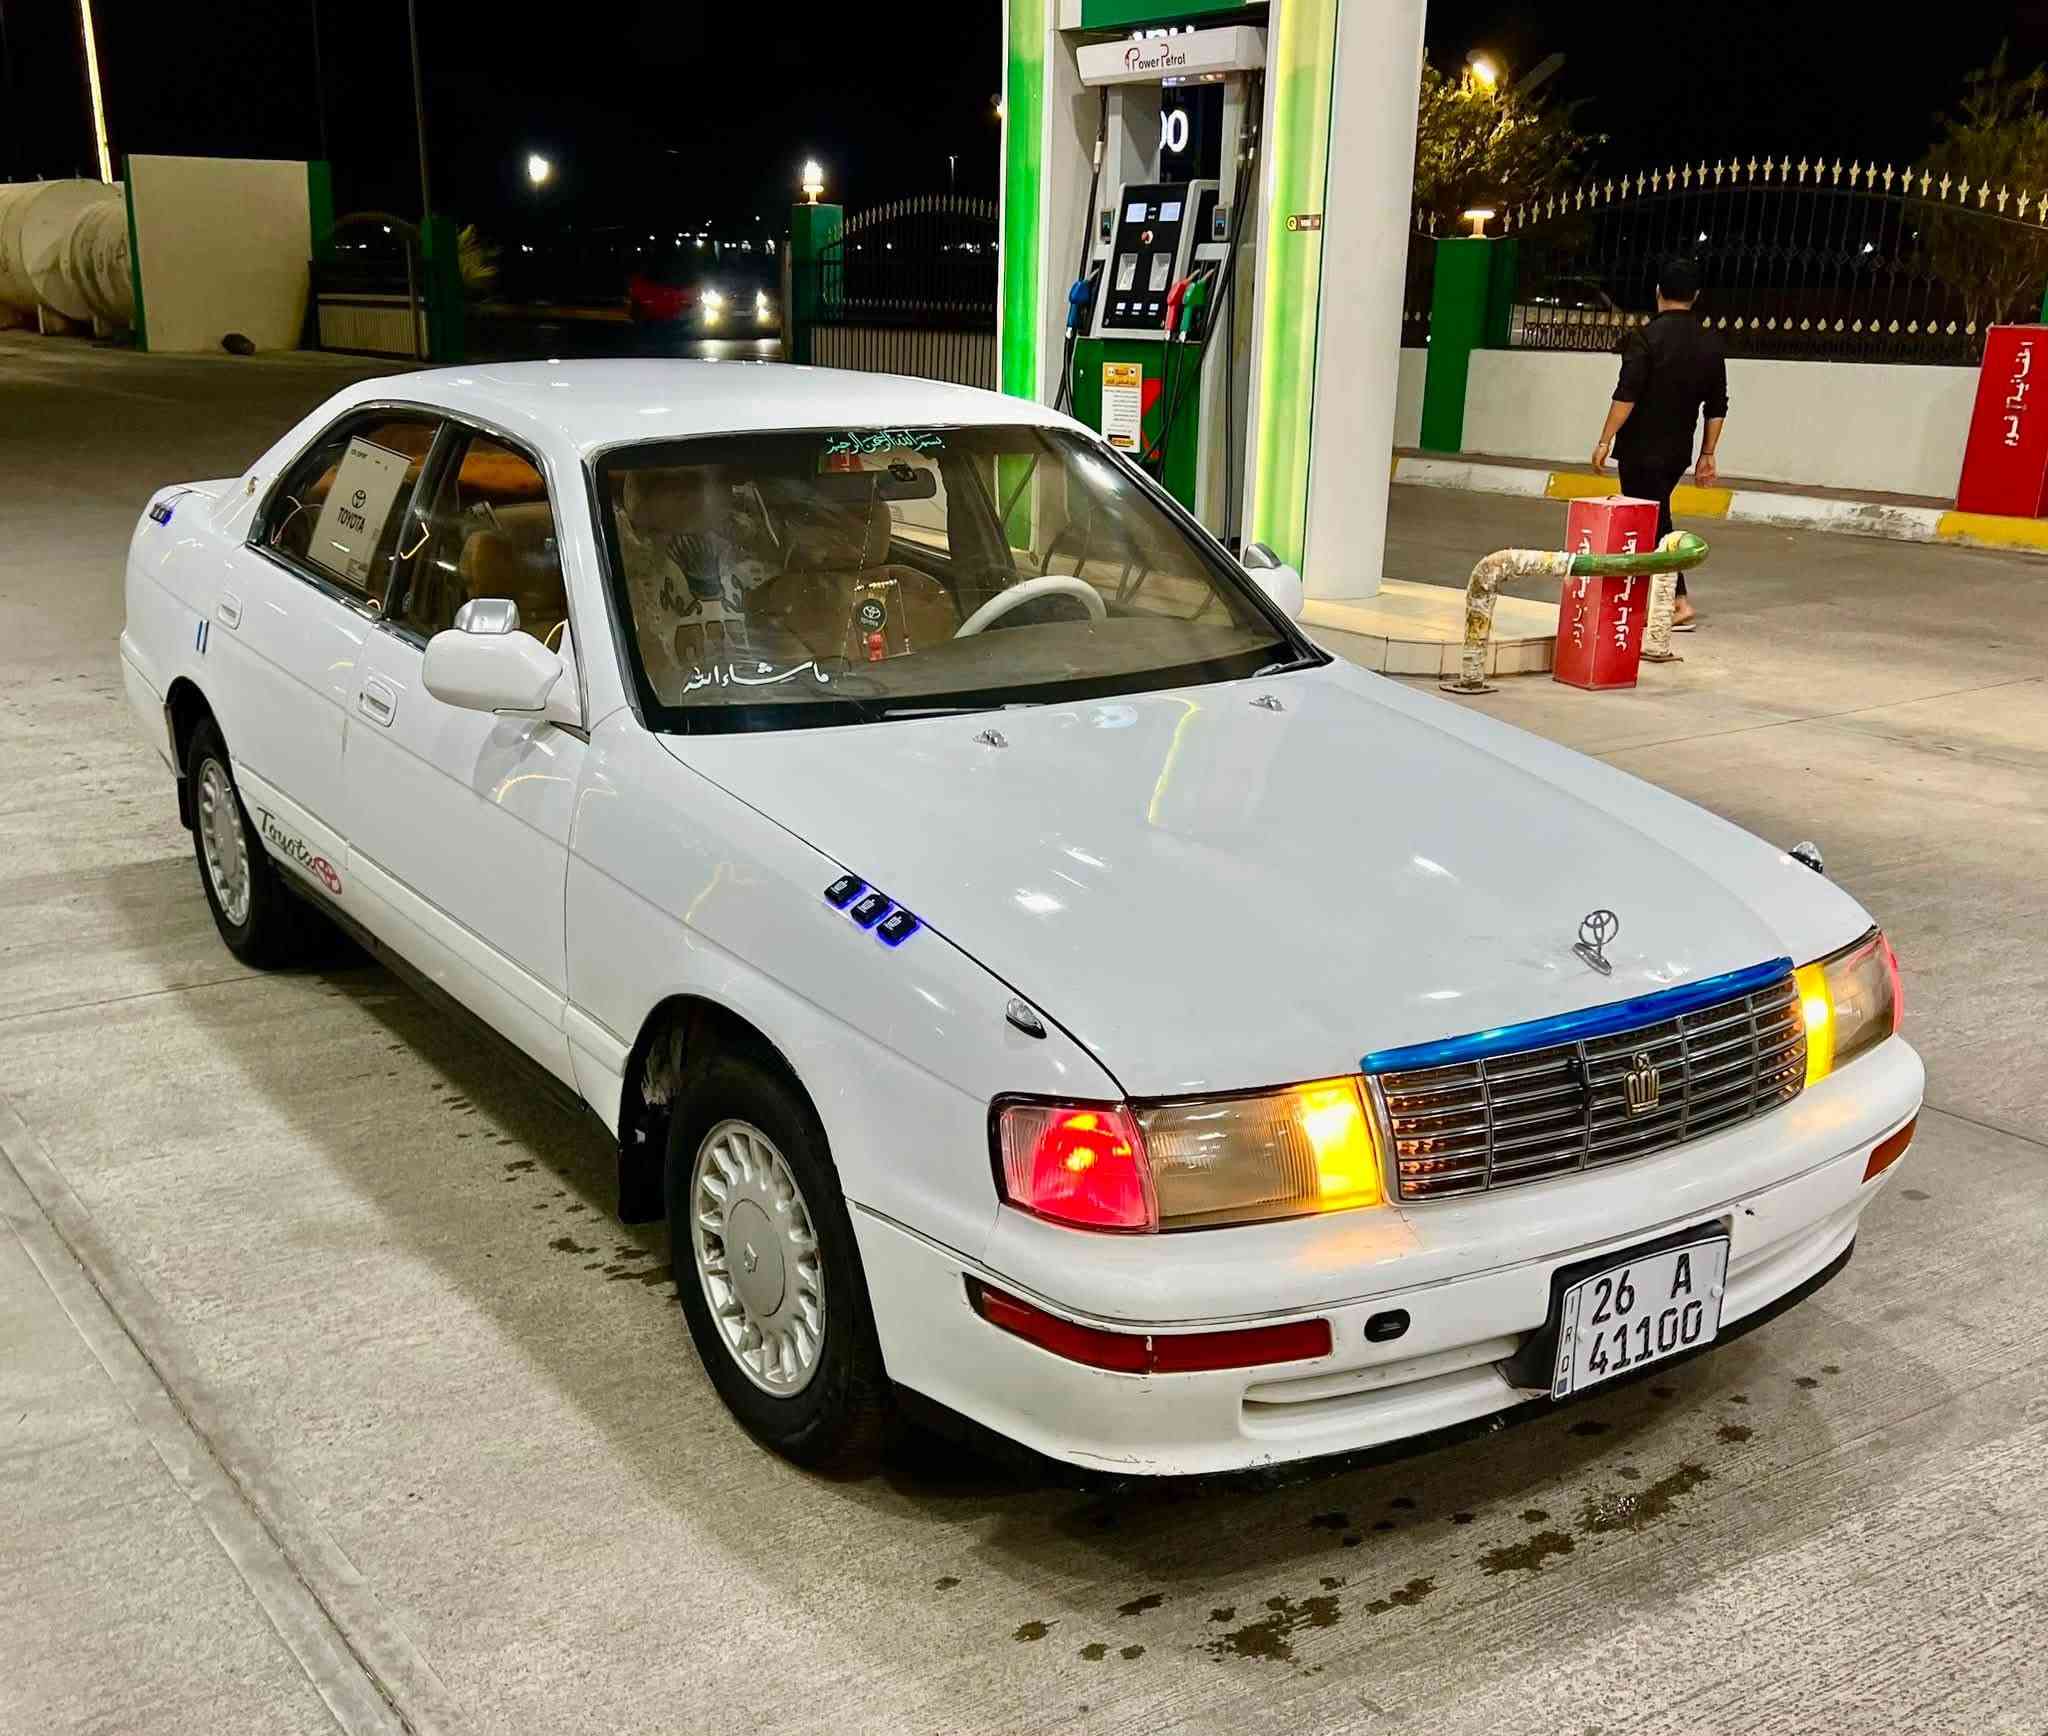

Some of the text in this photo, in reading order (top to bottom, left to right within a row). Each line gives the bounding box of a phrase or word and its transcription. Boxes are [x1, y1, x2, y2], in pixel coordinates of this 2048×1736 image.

[336, 507, 367, 534] TOYOTA
[682, 665, 720, 694] الله
[257, 807, 315, 871] Toyota
[1592, 1253, 1692, 1326] 26 A
[1589, 1300, 1702, 1375] 41100
